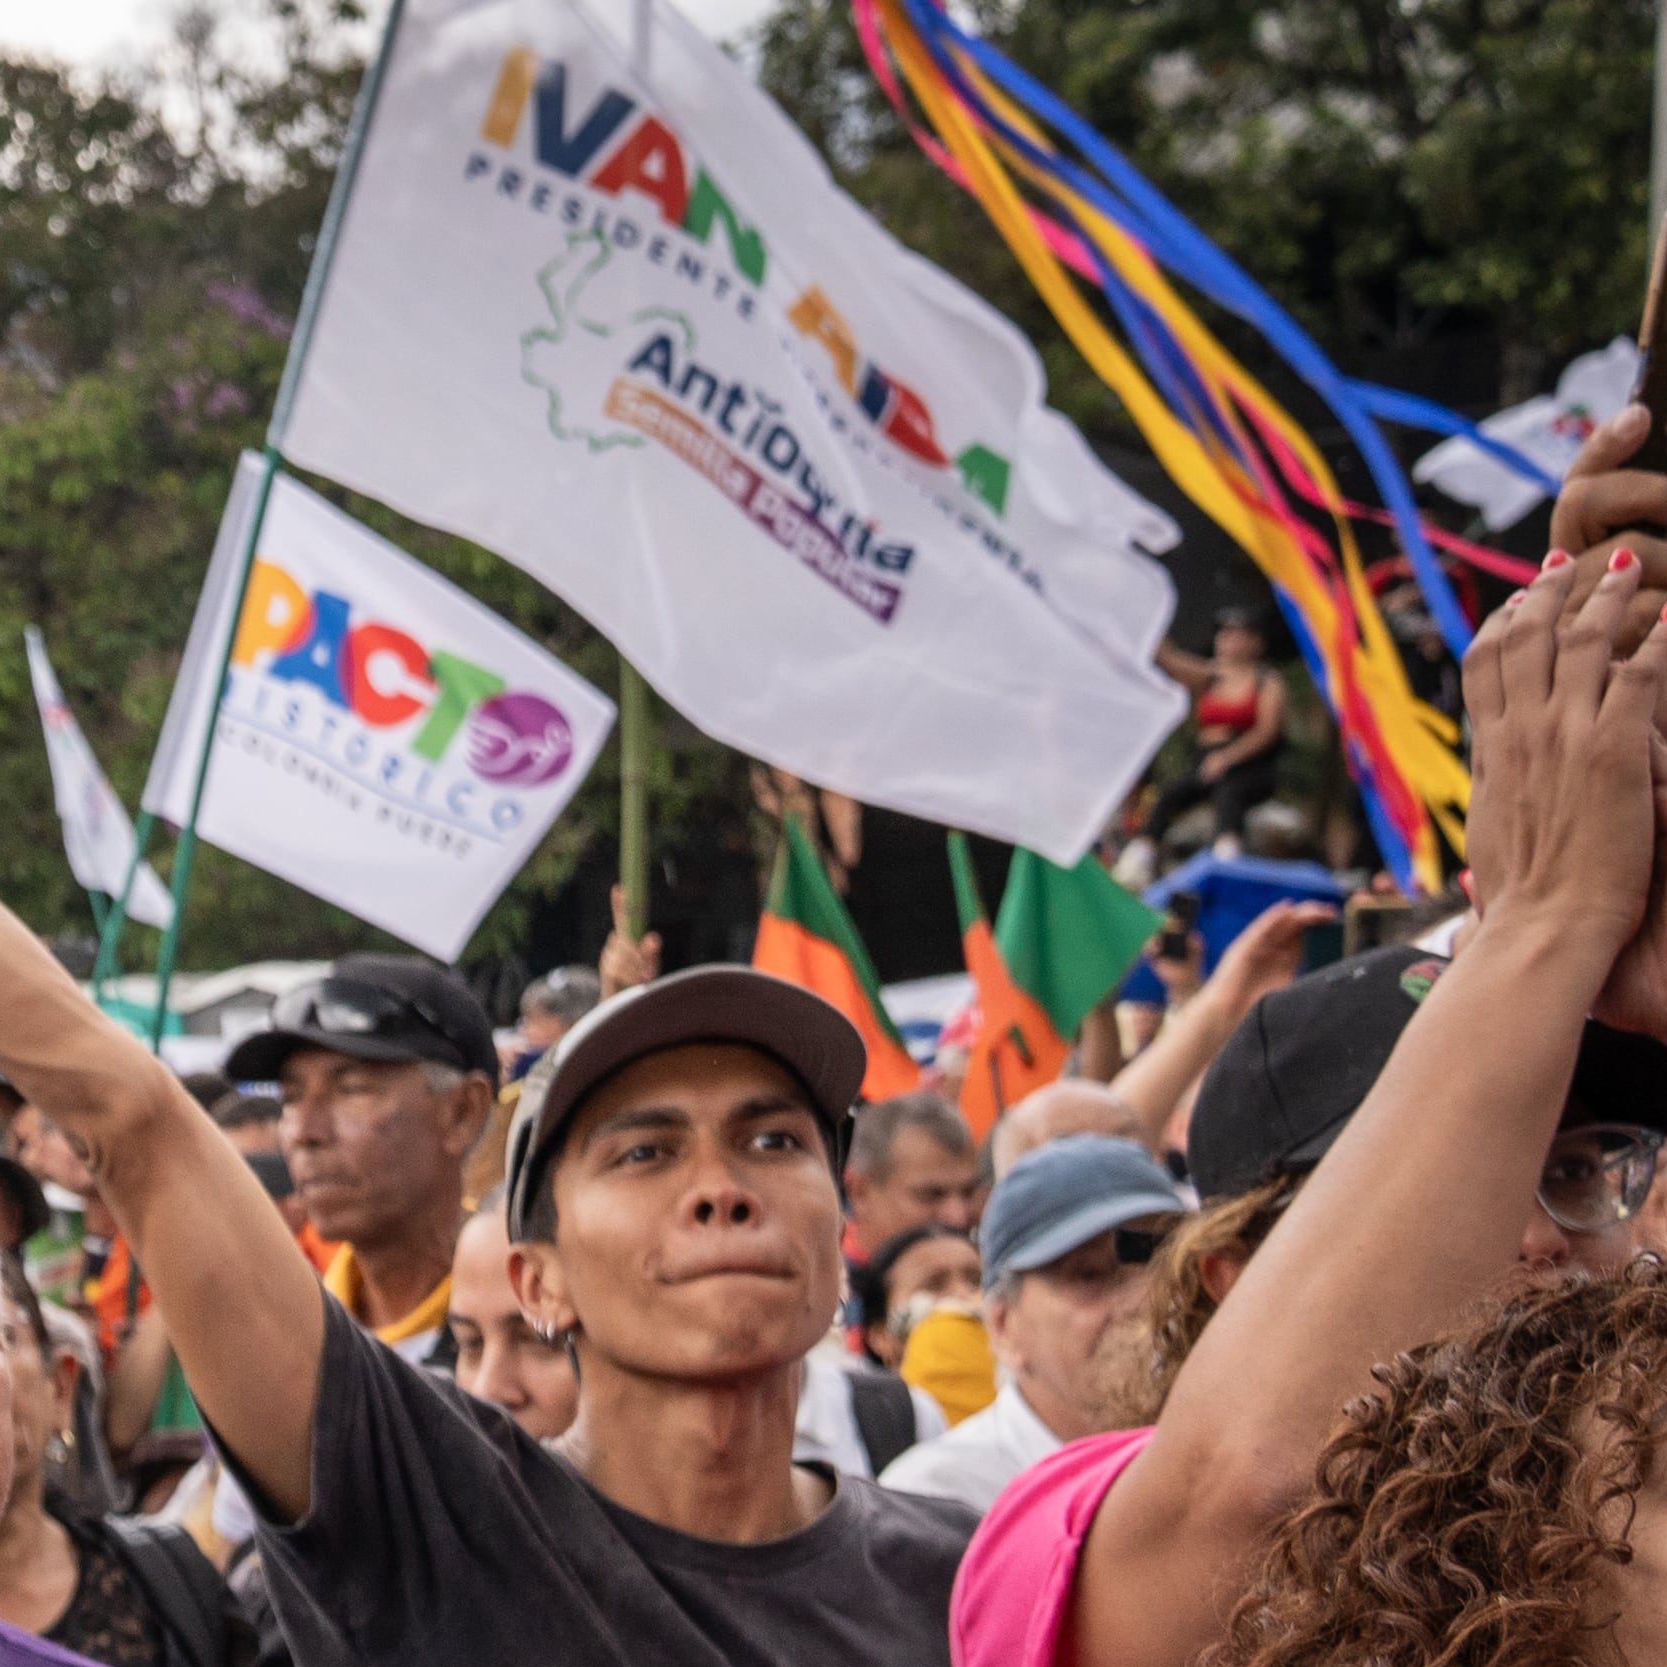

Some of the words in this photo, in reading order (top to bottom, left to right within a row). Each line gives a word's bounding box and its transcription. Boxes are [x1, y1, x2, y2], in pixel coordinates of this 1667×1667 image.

[464, 152, 756, 320] PRESIDENTE
[481, 47, 768, 289] IVAN
[757, 490, 897, 612] Popular
[230, 558, 575, 789] PACTO
